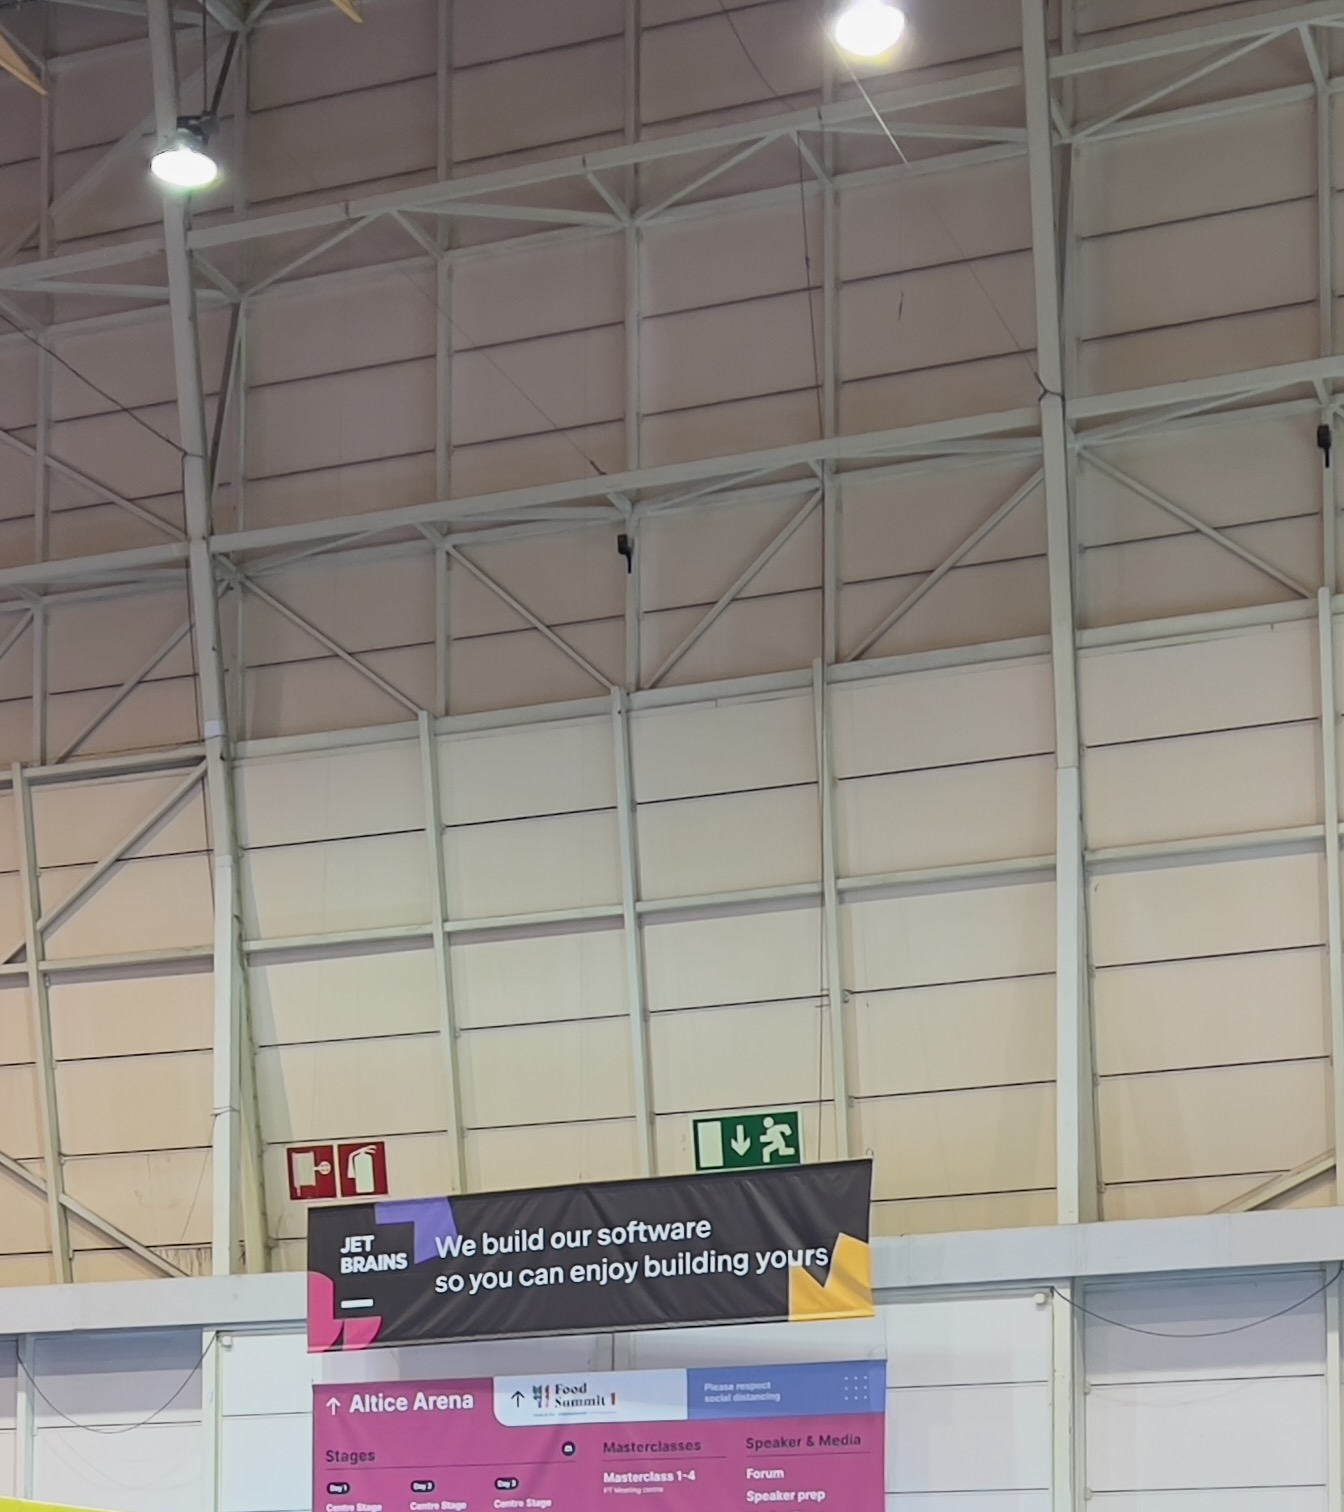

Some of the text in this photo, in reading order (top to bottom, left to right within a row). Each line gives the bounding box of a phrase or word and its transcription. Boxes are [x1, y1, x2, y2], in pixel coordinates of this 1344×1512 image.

[340, 1235, 374, 1254] JET
[435, 1219, 712, 1259] We build our software
[340, 1252, 407, 1274] BRAINS
[435, 1247, 829, 1295] so you can enjoy building yours
[555, 1382, 587, 1395] Food
[704, 1381, 771, 1393] Please respect
[349, 1391, 474, 1414] Altice Arena
[555, 1394, 605, 1408] Summit
[704, 1390, 781, 1403] social distancing
[603, 1439, 702, 1454] Masterclasses
[745, 1433, 861, 1452] Speaker & Media
[326, 1449, 376, 1466] Stages
[603, 1470, 674, 1483] Masterclass
[746, 1467, 785, 1480] Forum
[494, 1498, 552, 1510] Centre Stage
[746, 1490, 826, 1504] Speaker prep
[326, 1503, 355, 1512] Centre
[410, 1500, 467, 1511] Centre Stage
